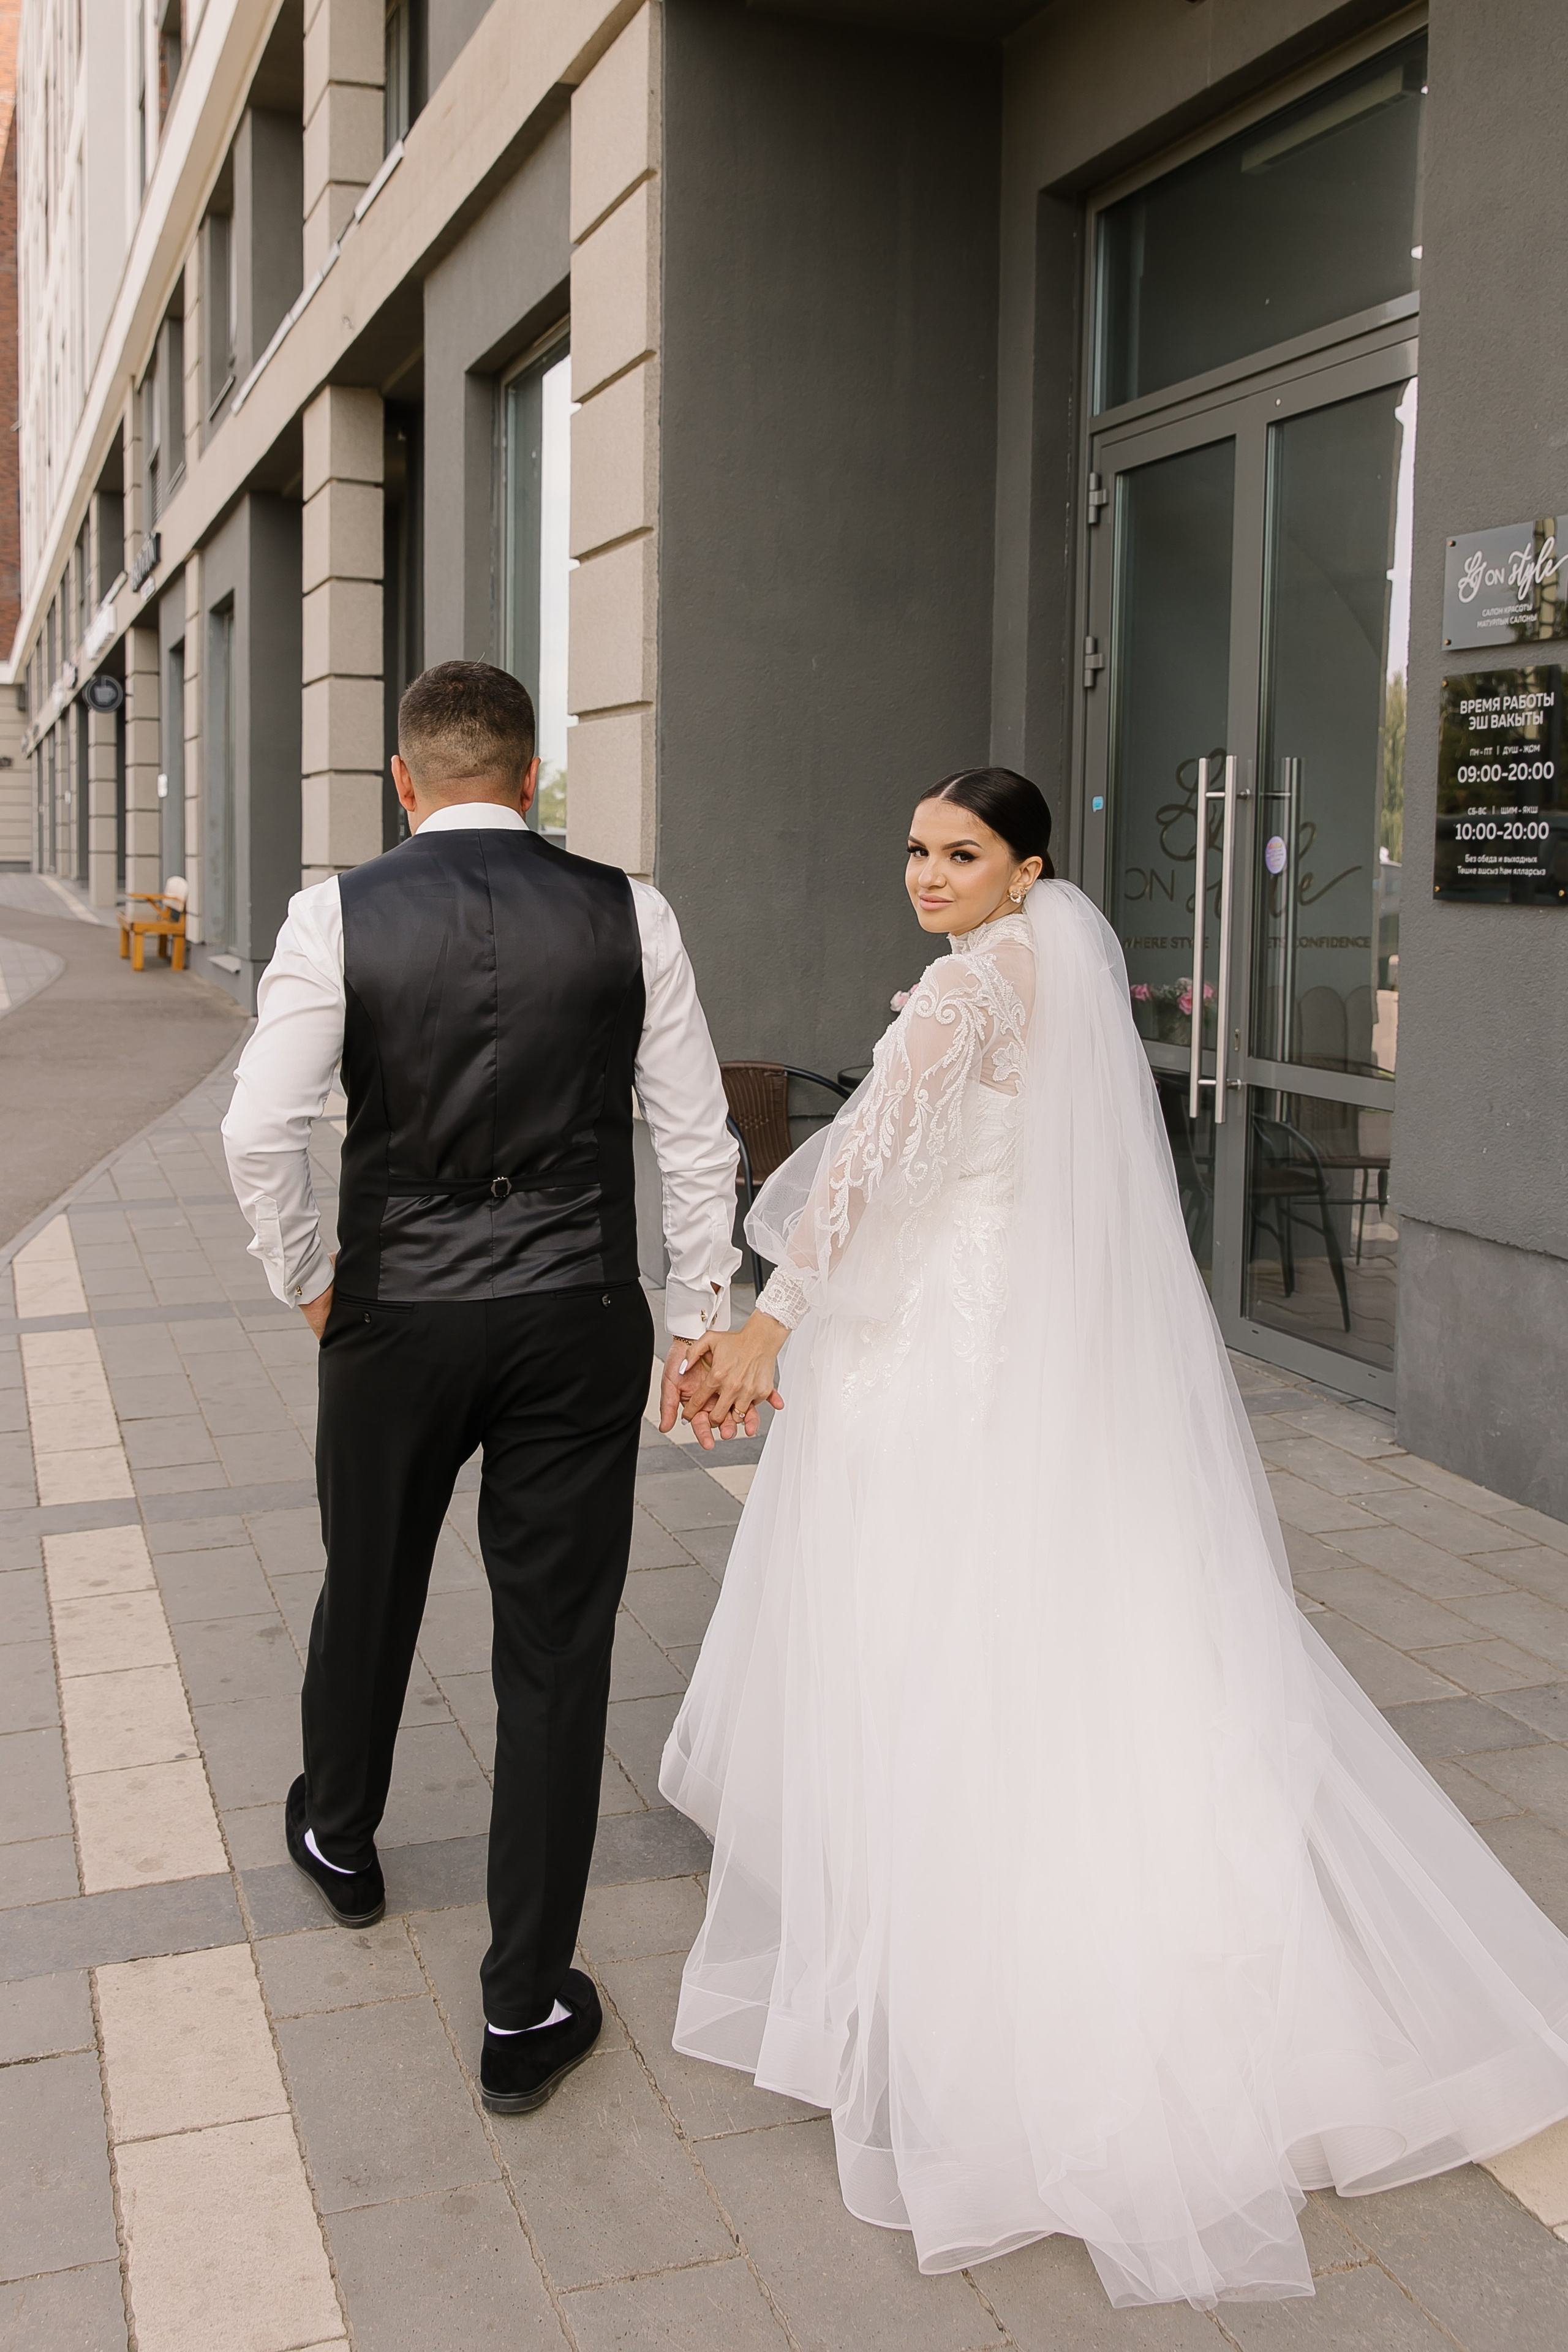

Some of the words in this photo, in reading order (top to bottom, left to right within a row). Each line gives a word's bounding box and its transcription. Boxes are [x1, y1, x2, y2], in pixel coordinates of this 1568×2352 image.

[1508, 536, 1568, 601] style
[1482, 607, 1504, 617] САЛОН
[1504, 603, 1533, 613] КРАСОТЫ
[1509, 613, 1537, 624] САЛОНЫ
[1460, 696, 1501, 715] ВРЕМЯ
[1502, 692, 1555, 710] РАБОТЫ
[1468, 715, 1489, 730] ЭШ
[1490, 710, 1544, 729] ВАКЫТЫ
[1457, 761, 1555, 783] 09:00-20:00
[1455, 821, 1550, 840] 10:00-20:00
[1464, 854, 1477, 863] Без
[1477, 854, 1498, 864] обеда
[1503, 856, 1538, 864] выходных
[1170, 937, 1209, 949] STYE
[1297, 936, 1372, 949] ONFIDENCE
